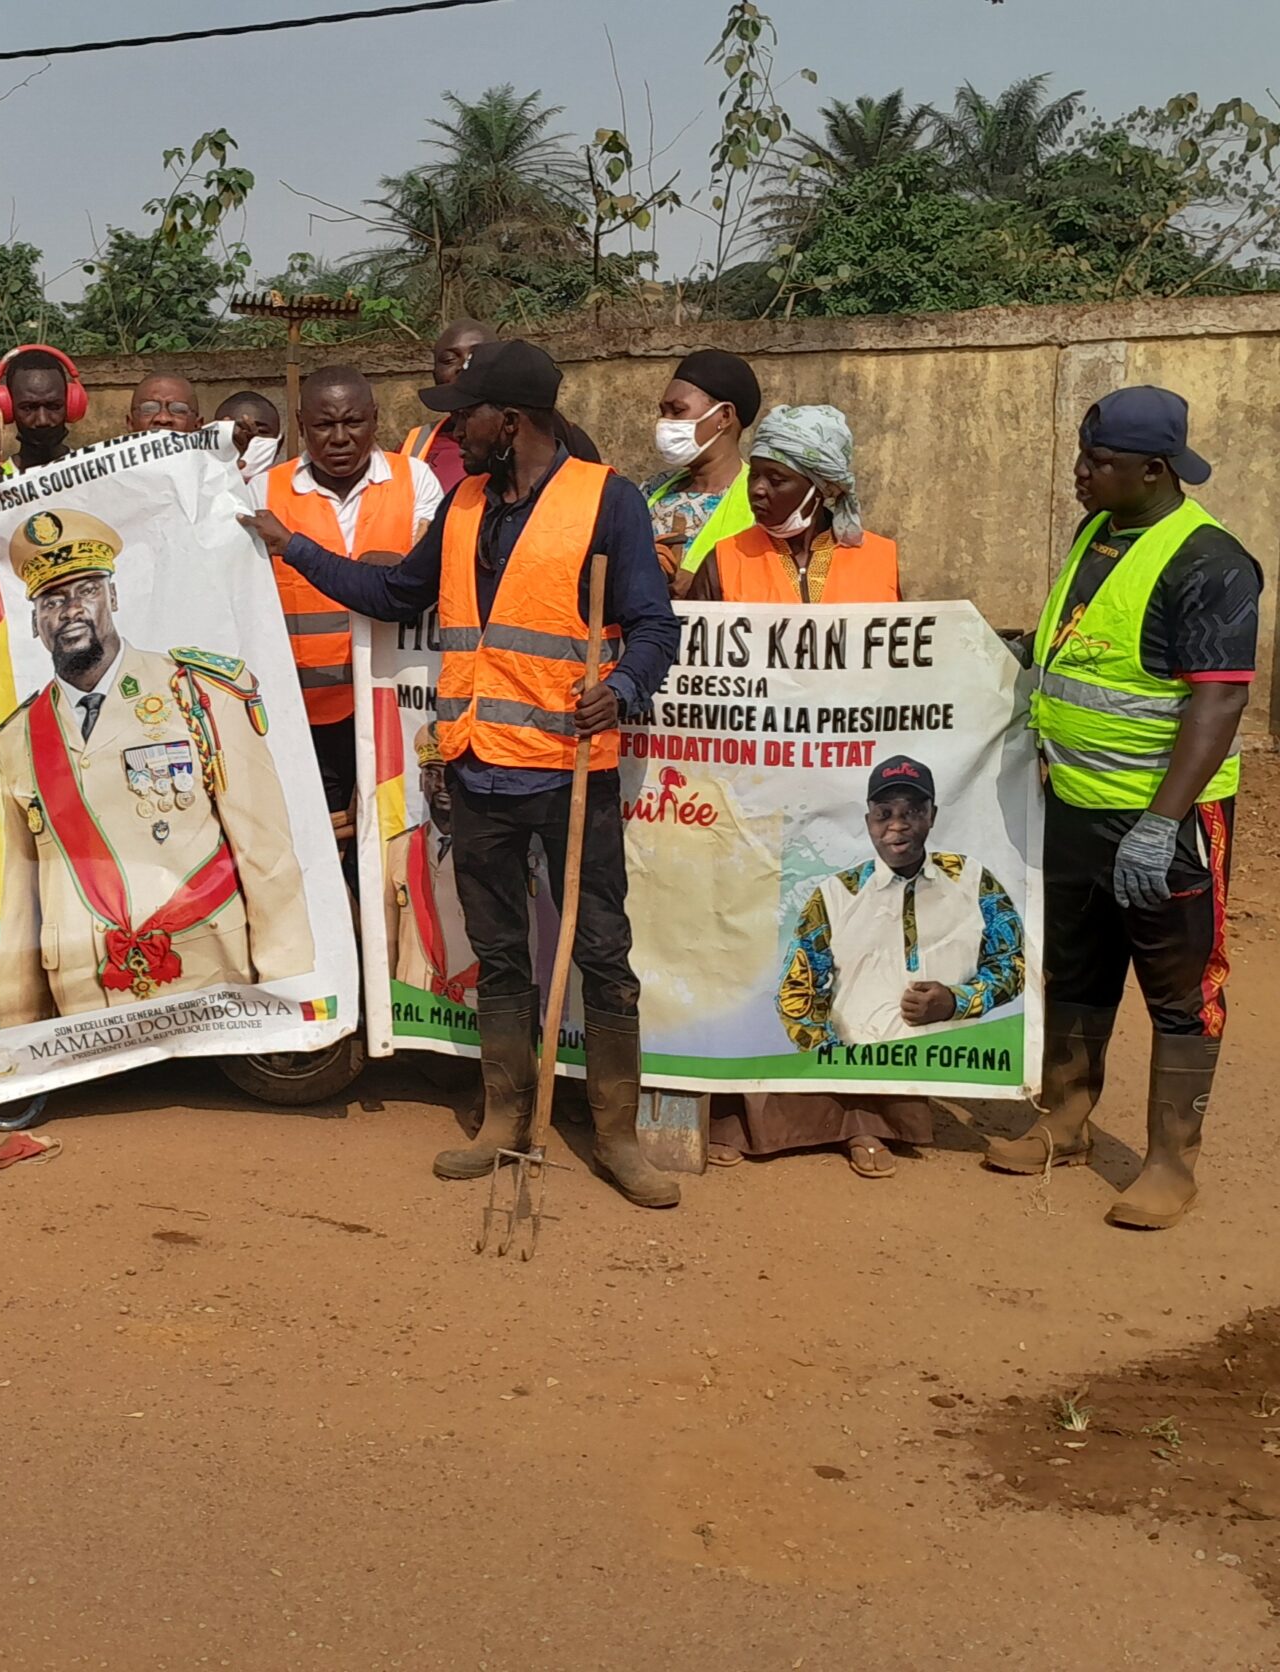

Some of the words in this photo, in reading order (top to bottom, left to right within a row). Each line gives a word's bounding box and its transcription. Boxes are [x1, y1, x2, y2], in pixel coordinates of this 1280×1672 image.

[39, 453, 117, 496] SOUTIENT
[120, 446, 136, 469] LE
[766, 617, 848, 670] KAN
[862, 616, 937, 669] FEE
[677, 674, 769, 698] GBESSIA
[662, 701, 757, 732] SERVICE
[761, 705, 778, 733] A
[784, 706, 811, 734] LA
[816, 703, 954, 734] PRESIDENCE
[764, 740, 796, 767] DE
[802, 740, 876, 768] L'ETAT
[28, 1024, 132, 1060] MAMADI
[136, 1000, 293, 1036] DOUMBOUYA
[54, 1024, 73, 1037] SON
[74, 1015, 124, 1033] EXCELLENCE
[126, 1007, 163, 1022] GENERAL
[165, 1004, 176, 1014] DE
[178, 996, 207, 1010] CORPS
[72, 1042, 121, 1060] PRESIDENT
[153, 1022, 211, 1040] REPUBLIQUE
[212, 1021, 225, 1031] DE
[227, 1019, 263, 1029] GUINEE
[817, 1044, 839, 1065] M.
[845, 1044, 918, 1067] KADER
[926, 1045, 1011, 1072] FOFANA
